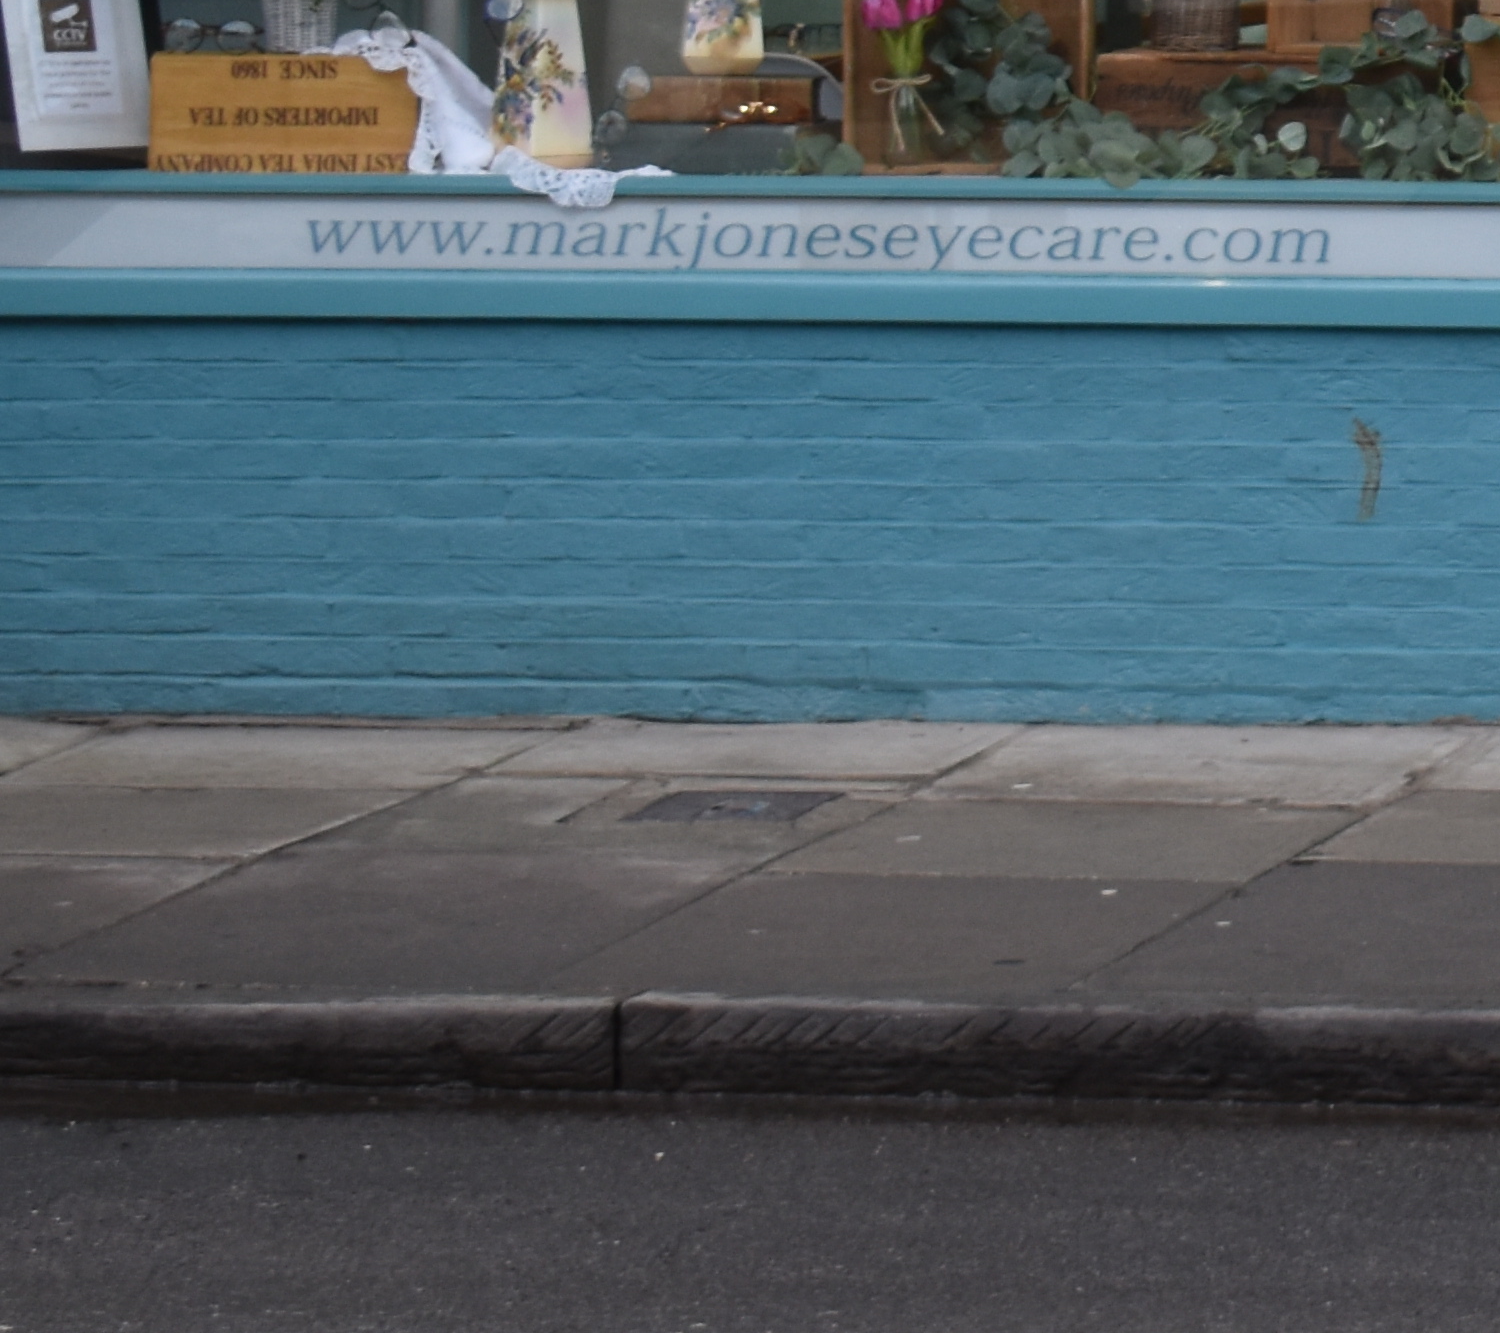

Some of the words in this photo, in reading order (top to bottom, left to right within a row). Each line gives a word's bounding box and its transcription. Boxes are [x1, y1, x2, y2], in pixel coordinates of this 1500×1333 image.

[53, 27, 88, 43] CCTV
[231, 60, 268, 80] 1860
[279, 59, 338, 80] SINCE
[188, 107, 225, 127] TEA
[234, 107, 259, 127] OF
[264, 107, 380, 127] IMPORTERS
[156, 153, 253, 173] COMPANY
[259, 153, 294, 173] TEA
[304, 153, 357, 173] INDIA
[306, 207, 1332, 270] www.markjoneseyecare.com
